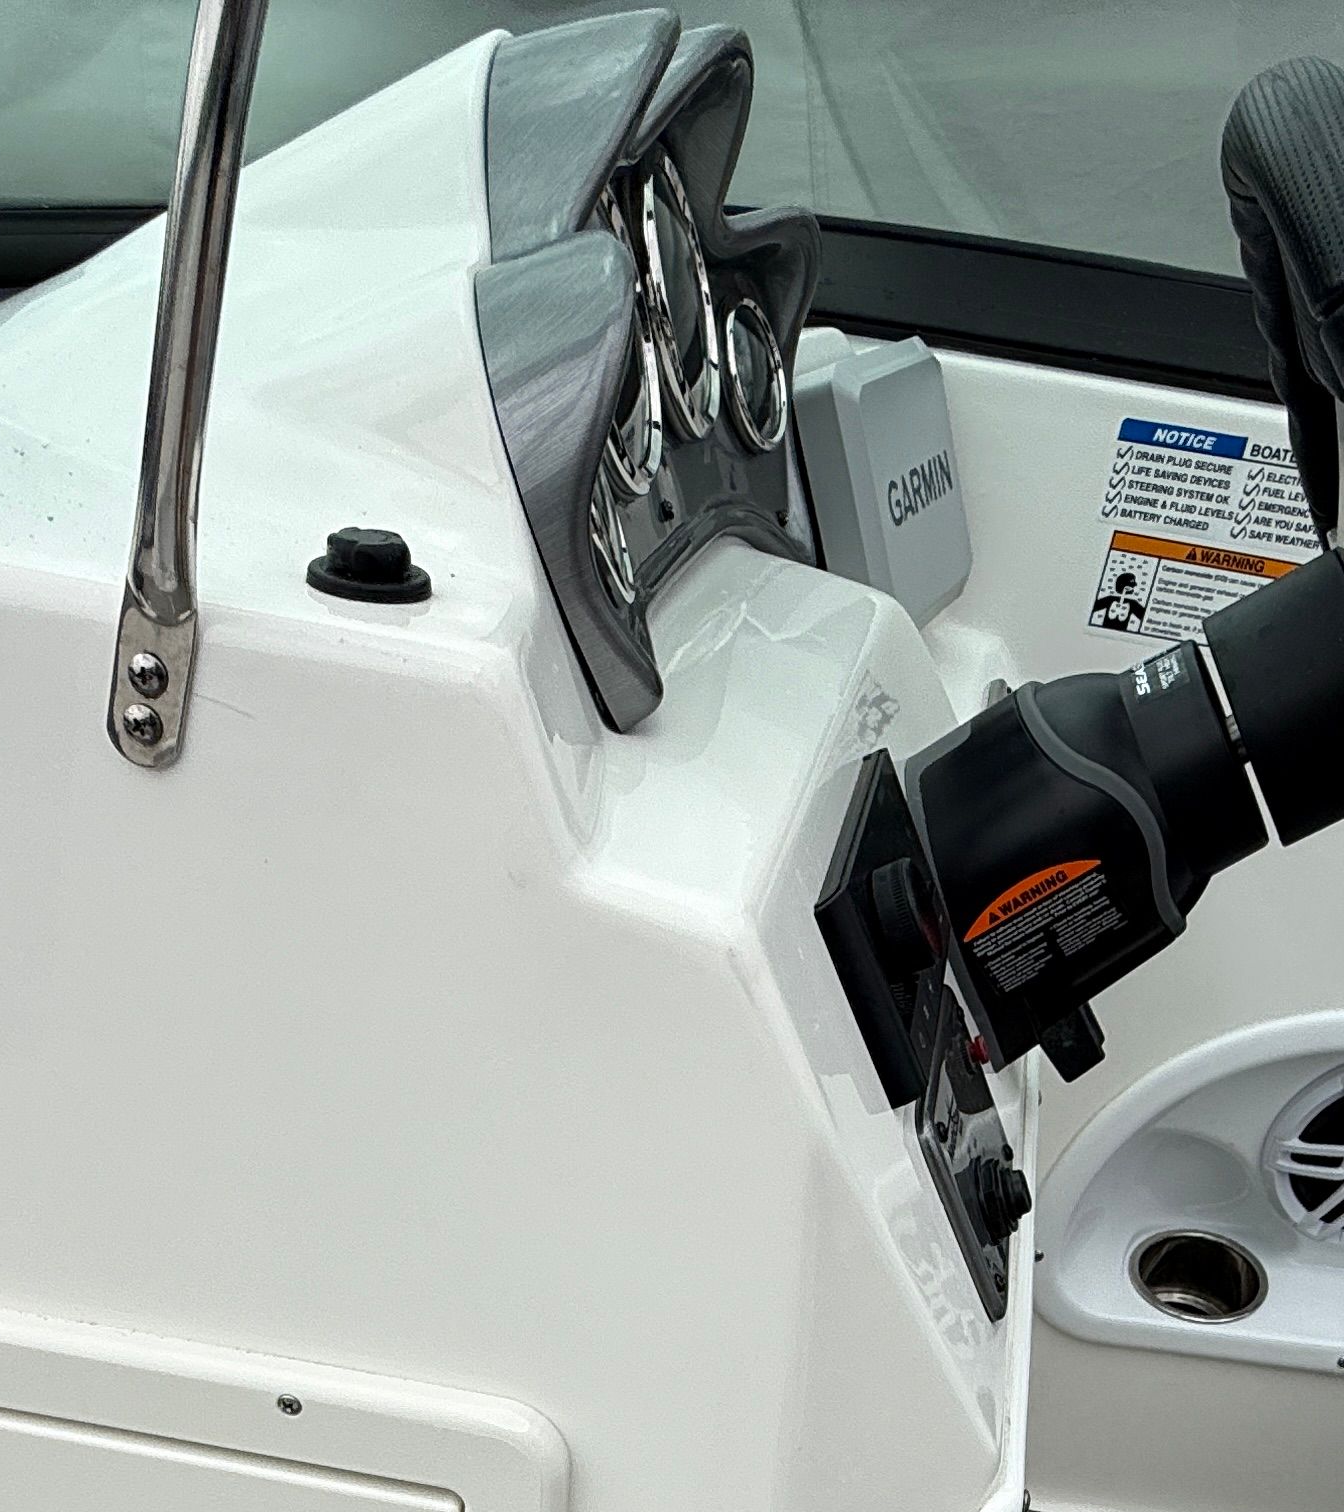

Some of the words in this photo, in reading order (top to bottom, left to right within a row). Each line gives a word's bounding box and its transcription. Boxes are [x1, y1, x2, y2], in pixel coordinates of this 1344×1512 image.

[1153, 428, 1217, 451] NOTICE
[1136, 450, 1165, 464] DRAIN
[1166, 455, 1193, 469] PLUG
[1194, 460, 1234, 476] SECURE
[887, 450, 953, 526] GARMIN
[1131, 465, 1152, 477] LIFE
[1154, 468, 1188, 483] SAVING
[1189, 474, 1231, 490] DEVICES
[1128, 479, 1175, 496] STEERING
[1176, 487, 1215, 502] SYSTEM
[1215, 494, 1231, 506] OK
[1262, 487, 1285, 500] FUEL
[1288, 490, 1307, 503] LEV
[1123, 493, 1159, 509] ENGINE
[1160, 500, 1168, 510] &
[1169, 501, 1197, 515] FLUID
[1197, 506, 1235, 521] LEVELS
[1257, 501, 1310, 519] EMERGENC
[1119, 508, 1162, 524] BATTERY
[1163, 515, 1209, 531] CHARGED
[1253, 516, 1272, 528] ARE
[1274, 519, 1294, 531] YOU
[1248, 530, 1273, 542] SAFE
[1275, 535, 1320, 549] WEATHER
[1200, 549, 1265, 573] WARNING
[1133, 663, 1151, 696] SEA
[998, 870, 1069, 918] WARNING
